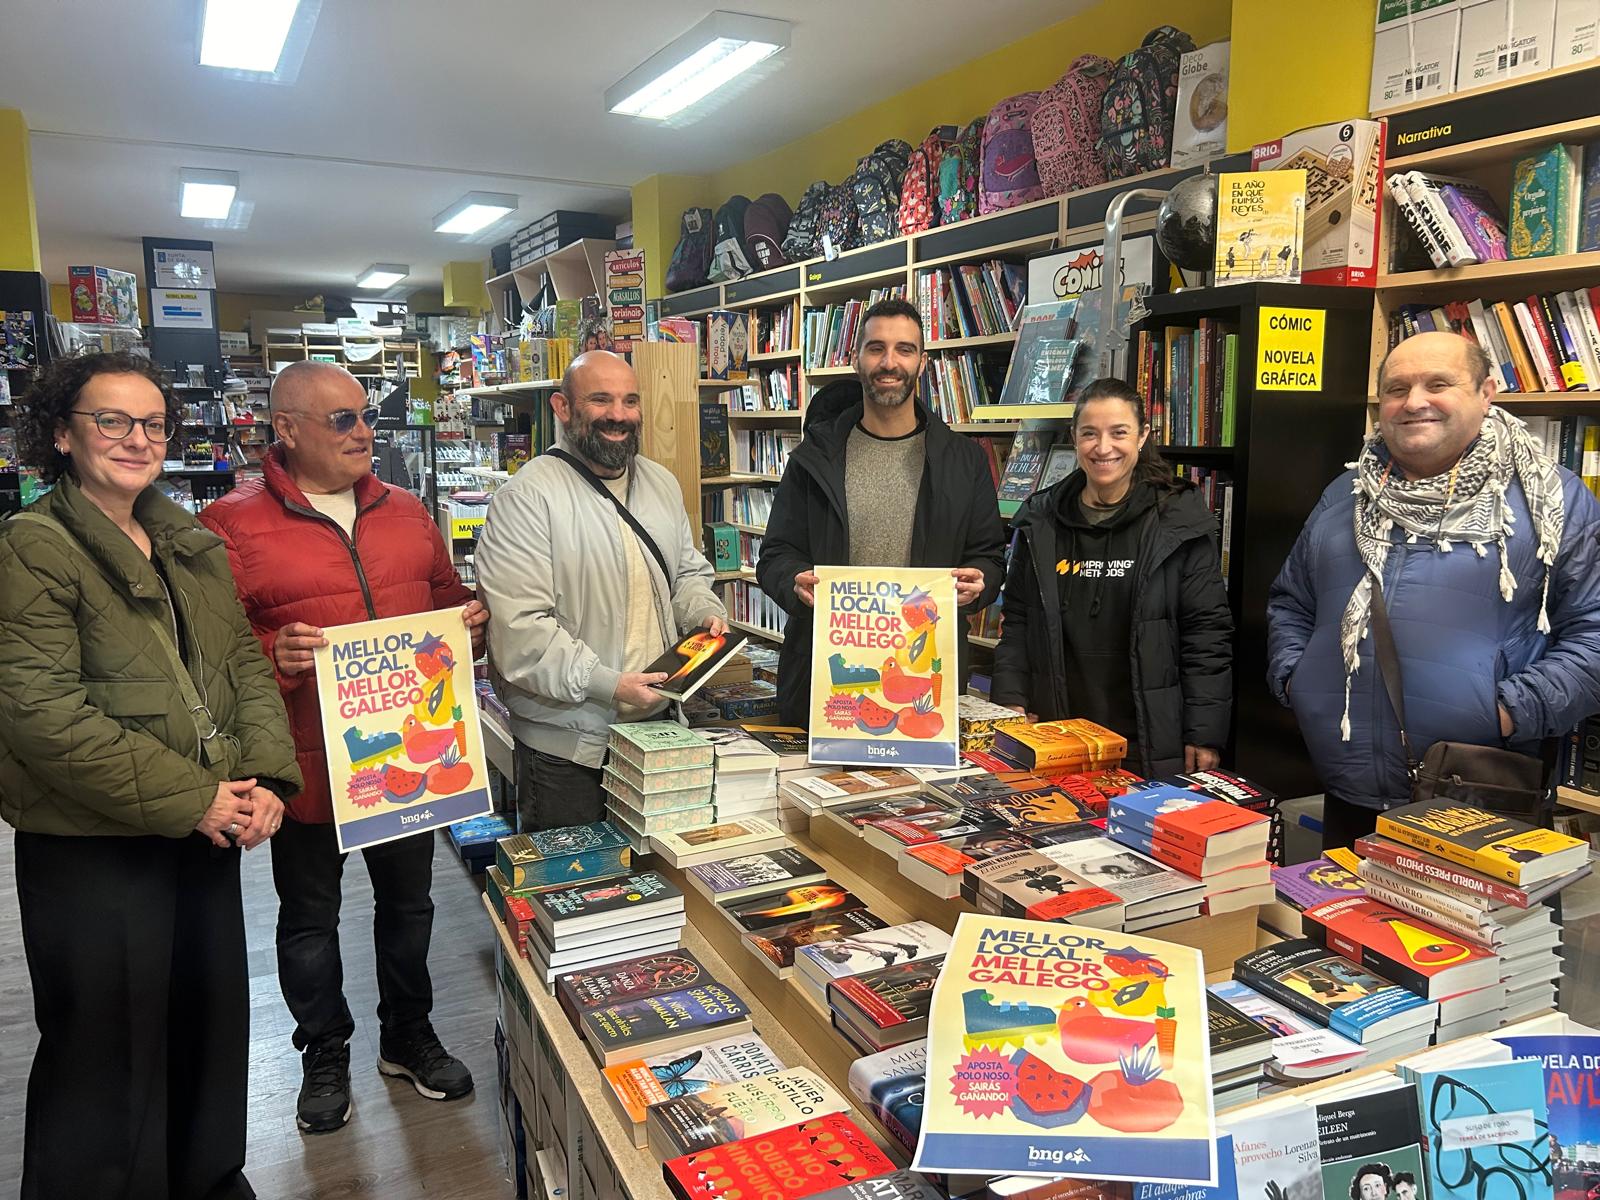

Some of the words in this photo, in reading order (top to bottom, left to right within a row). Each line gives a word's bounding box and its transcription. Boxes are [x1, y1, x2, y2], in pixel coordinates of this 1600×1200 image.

[1497, 36, 1538, 52] NAIGATOR
[1183, 53, 1204, 65] Deco
[1182, 62, 1208, 76] Globe
[1342, 125, 1351, 138] 6
[1397, 125, 1453, 146] Narrativa
[1253, 144, 1279, 161] BRIO
[1232, 182, 1244, 190] EL
[1245, 180, 1266, 189] AÑO
[1232, 190, 1243, 198] EN
[1246, 189, 1264, 198] QUE
[1232, 197, 1264, 205] FUIMOS
[1231, 205, 1264, 217] REYES
[1522, 205, 1546, 219] perjuicio
[1053, 257, 1125, 297] COMI
[613, 290, 640, 301] AGASALLOS
[613, 309, 641, 318] orixinais
[1269, 315, 1312, 332] CÓMIC
[1264, 350, 1315, 365] NOVELA
[1261, 370, 1317, 387] GRÁFICA
[831, 581, 902, 598] MELLOR
[830, 595, 896, 616] LOCAL.
[829, 612, 903, 633] MELLOR
[332, 633, 413, 663] MELLOR
[829, 630, 912, 650] GALEGO.
[335, 656, 410, 682] LOCAL.
[337, 669, 419, 701] MELLOR
[340, 687, 430, 720] GALEGO.
[867, 745, 886, 757] bng
[400, 812, 420, 825] bng
[972, 859, 996, 871] DANIEL
[996, 851, 1034, 863] KEHLMANN
[989, 859, 1018, 871] director
[1396, 854, 1424, 872] PHOTO
[1425, 861, 1451, 882] PRESS
[1361, 869, 1384, 883] JULIA
[1385, 878, 1423, 899] NAVARRO
[1452, 873, 1484, 892] WORLD
[1370, 887, 1392, 904] JULIA
[1394, 897, 1433, 918] NAVARRO
[980, 928, 1106, 950] MELLOR
[976, 941, 1093, 962] LOCAL.
[971, 955, 1104, 978] MELLOR
[581, 976, 605, 1002] LLAMAS
[597, 976, 609, 992] MAR
[615, 971, 635, 991] DANZA
[968, 968, 1119, 994] GALEGO.
[687, 989, 723, 1016] SPARKS
[703, 984, 741, 1016] NICHOLAS
[667, 1000, 692, 1021] NIGHT
[720, 1044, 759, 1080] CARRIS
[740, 1041, 779, 1076] DONATO
[890, 1047, 926, 1065] MIKE
[883, 1060, 926, 1079] SANT
[967, 1061, 1003, 1071] APOSTA
[957, 1072, 981, 1081] POLO
[983, 1071, 1013, 1082] NOSO.
[767, 1076, 814, 1115] CASTILLO
[787, 1076, 824, 1105] JAVIER
[960, 1089, 1009, 1102] GAÑANDO!
[968, 1081, 1001, 1092] SAIRÁS
[1337, 1110, 1356, 1119] Berga
[1318, 1122, 1348, 1136] EILEEN
[1487, 1130, 1519, 1138] SACRIFICIO
[1028, 1145, 1065, 1164] bng
[1233, 1140, 1267, 1154] Afanes
[1285, 1138, 1318, 1156] Lorenzo
[755, 1140, 808, 1190] QUEDÓ
[786, 1140, 803, 1154] Y
[797, 1150, 825, 1176] NO
[1241, 1149, 1283, 1166] provecho
[1298, 1150, 1319, 1164] Silva
[726, 1142, 784, 1200] NINGUNO
[1141, 1185, 1152, 1199] El
